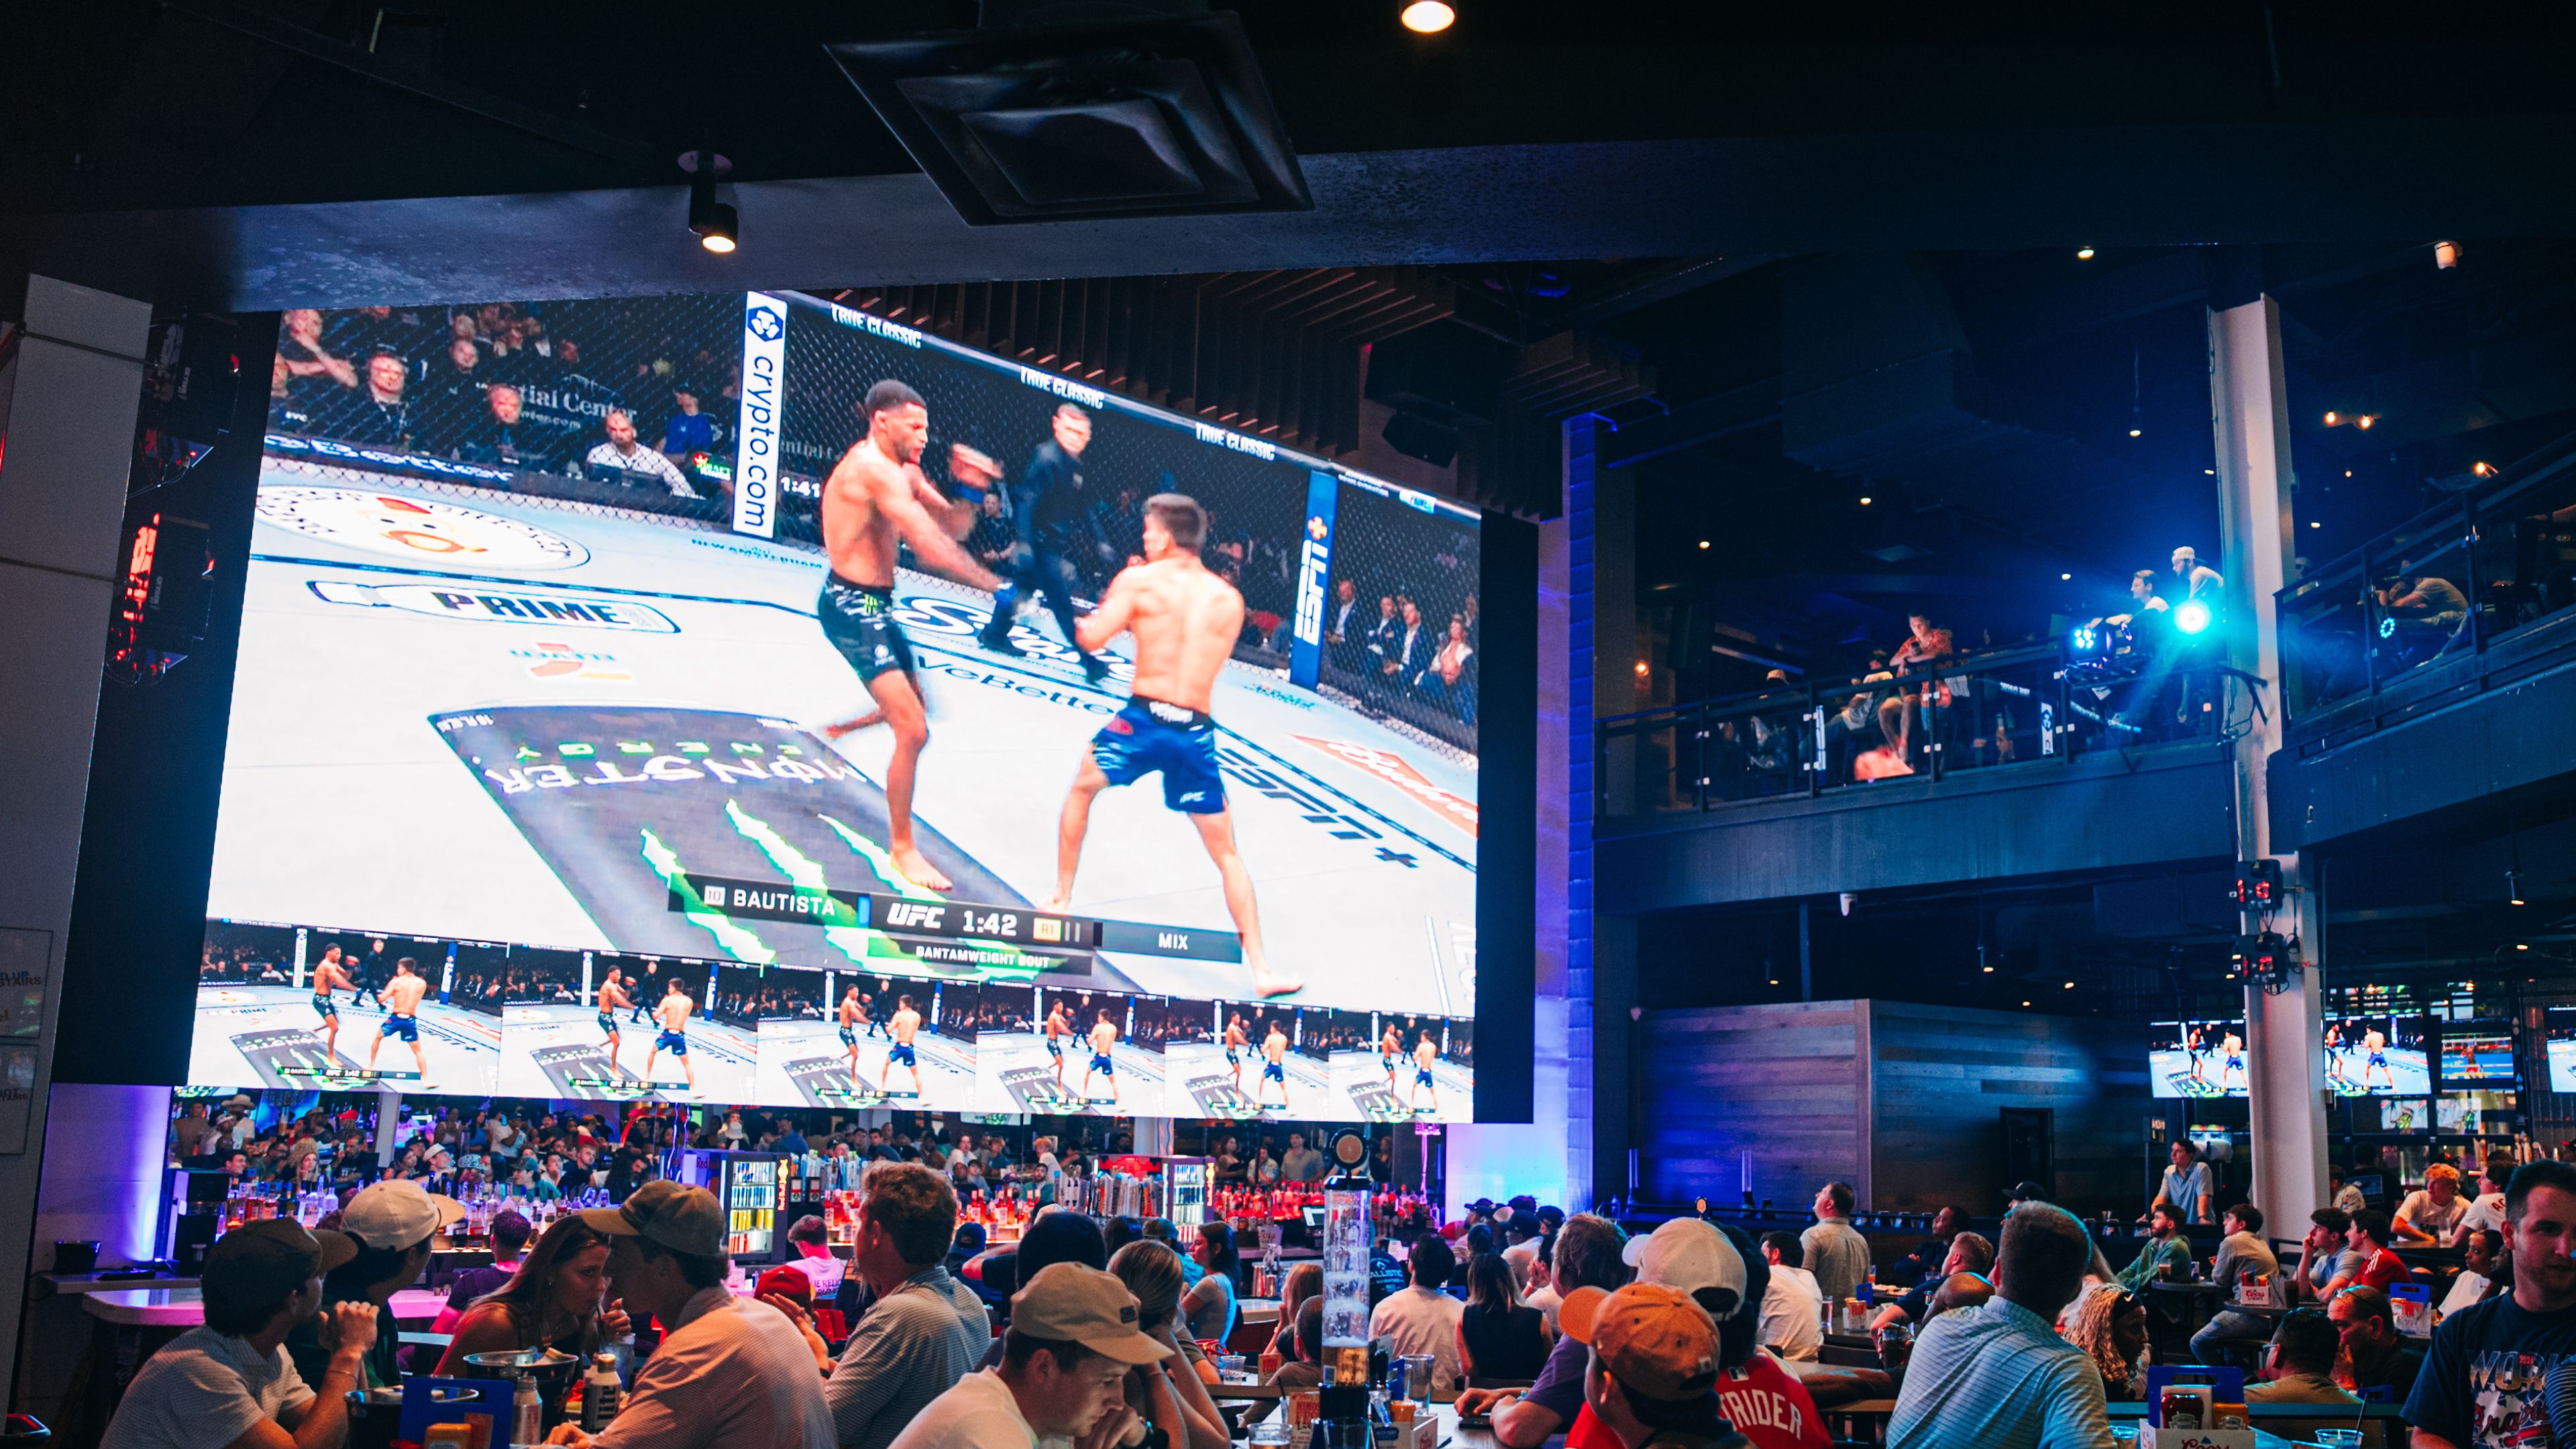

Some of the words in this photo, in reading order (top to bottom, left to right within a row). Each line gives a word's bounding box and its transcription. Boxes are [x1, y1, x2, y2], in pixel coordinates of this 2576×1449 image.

[830, 303, 866, 329] TRUE
[867, 315, 923, 349] CLASSIC
[1020, 365, 1053, 391] TRUE
[1053, 377, 1106, 409] CLASSIC
[745, 355, 774, 527] crypto.com
[1195, 421, 1226, 446] TRUE
[1226, 432, 1276, 462] CLASSIC
[780, 476, 820, 498] 1:41
[431, 591, 631, 625] PRIME
[917, 654, 1116, 716] VeBette
[707, 890, 722, 902] 10
[733, 888, 836, 916] BAUTISTA
[886, 902, 946, 929] UFC
[963, 910, 1018, 936] 1:42
[1040, 922, 1056, 935] R1
[1159, 932, 1188, 951] MIX
[916, 945, 1016, 965] BANTAMWEIGHT
[1018, 953, 1051, 969] BOUT
[1370, 1269, 1403, 1279] ALLISTIC
[2469, 1349, 2559, 1393] WOR
[1719, 1388, 1802, 1441] TRIDER
